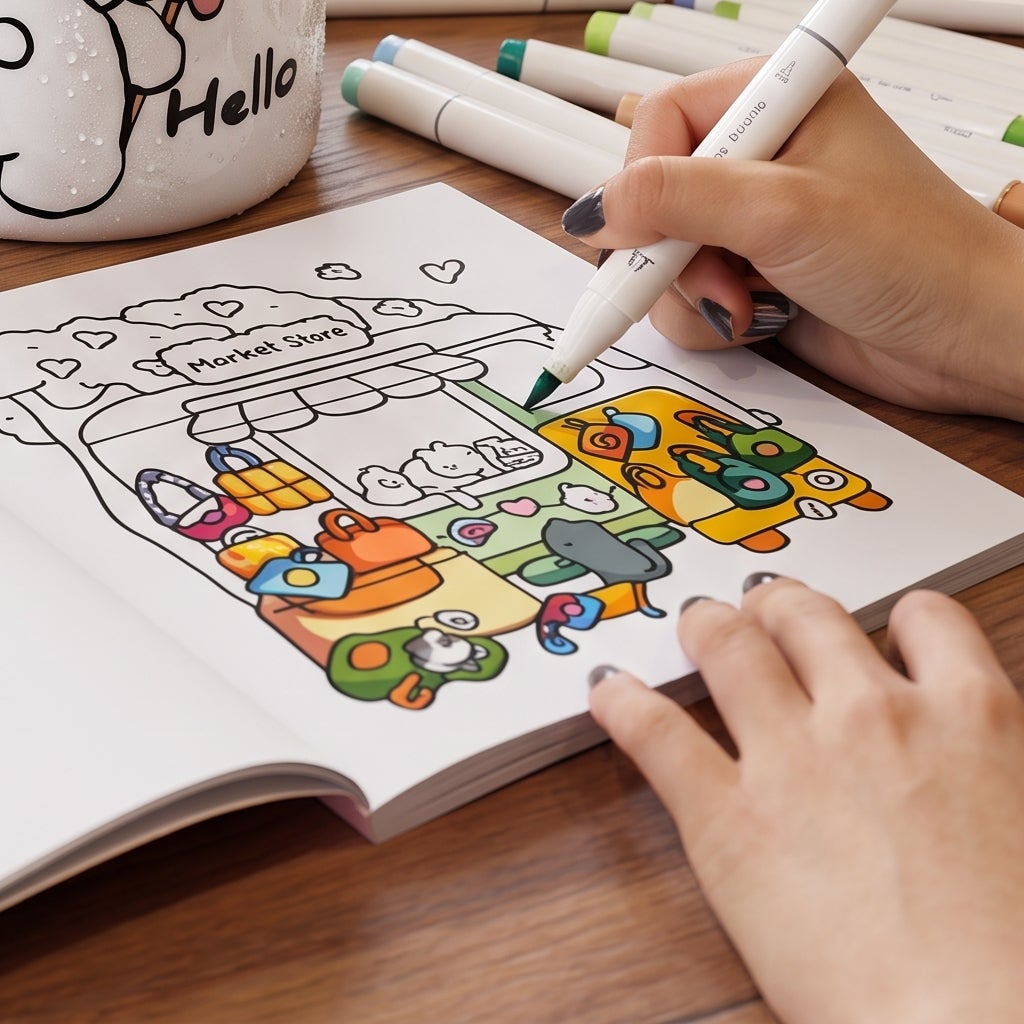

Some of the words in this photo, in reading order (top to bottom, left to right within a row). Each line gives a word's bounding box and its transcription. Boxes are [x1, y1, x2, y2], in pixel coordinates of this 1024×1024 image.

[166, 46, 298, 138] Hello
[187, 340, 283, 373] Market
[282, 327, 348, 348] Store
